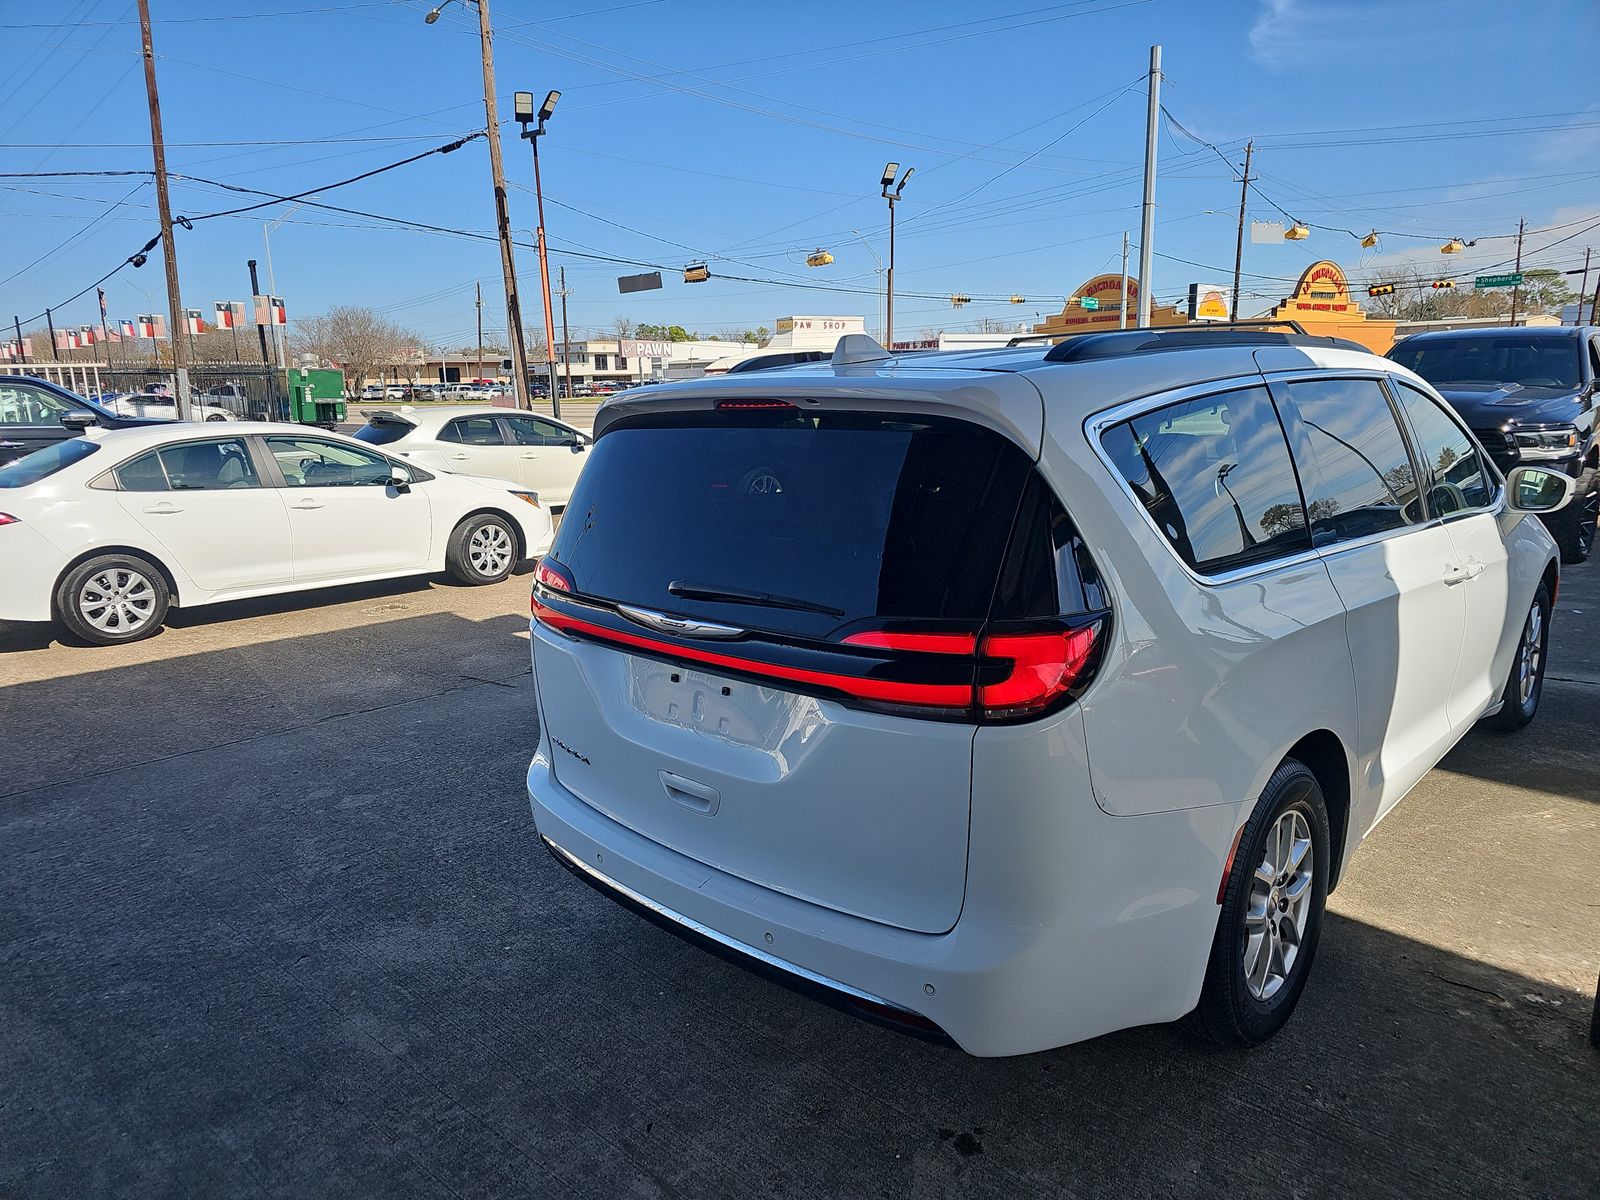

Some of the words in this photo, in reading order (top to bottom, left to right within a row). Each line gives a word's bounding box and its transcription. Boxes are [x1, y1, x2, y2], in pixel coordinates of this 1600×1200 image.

[1481, 275, 1513, 283] Shepherd
[794, 321, 812, 330] PAW
[823, 321, 846, 330] SHOP
[636, 342, 672, 356] PAWN
[893, 342, 910, 350] PAWN
